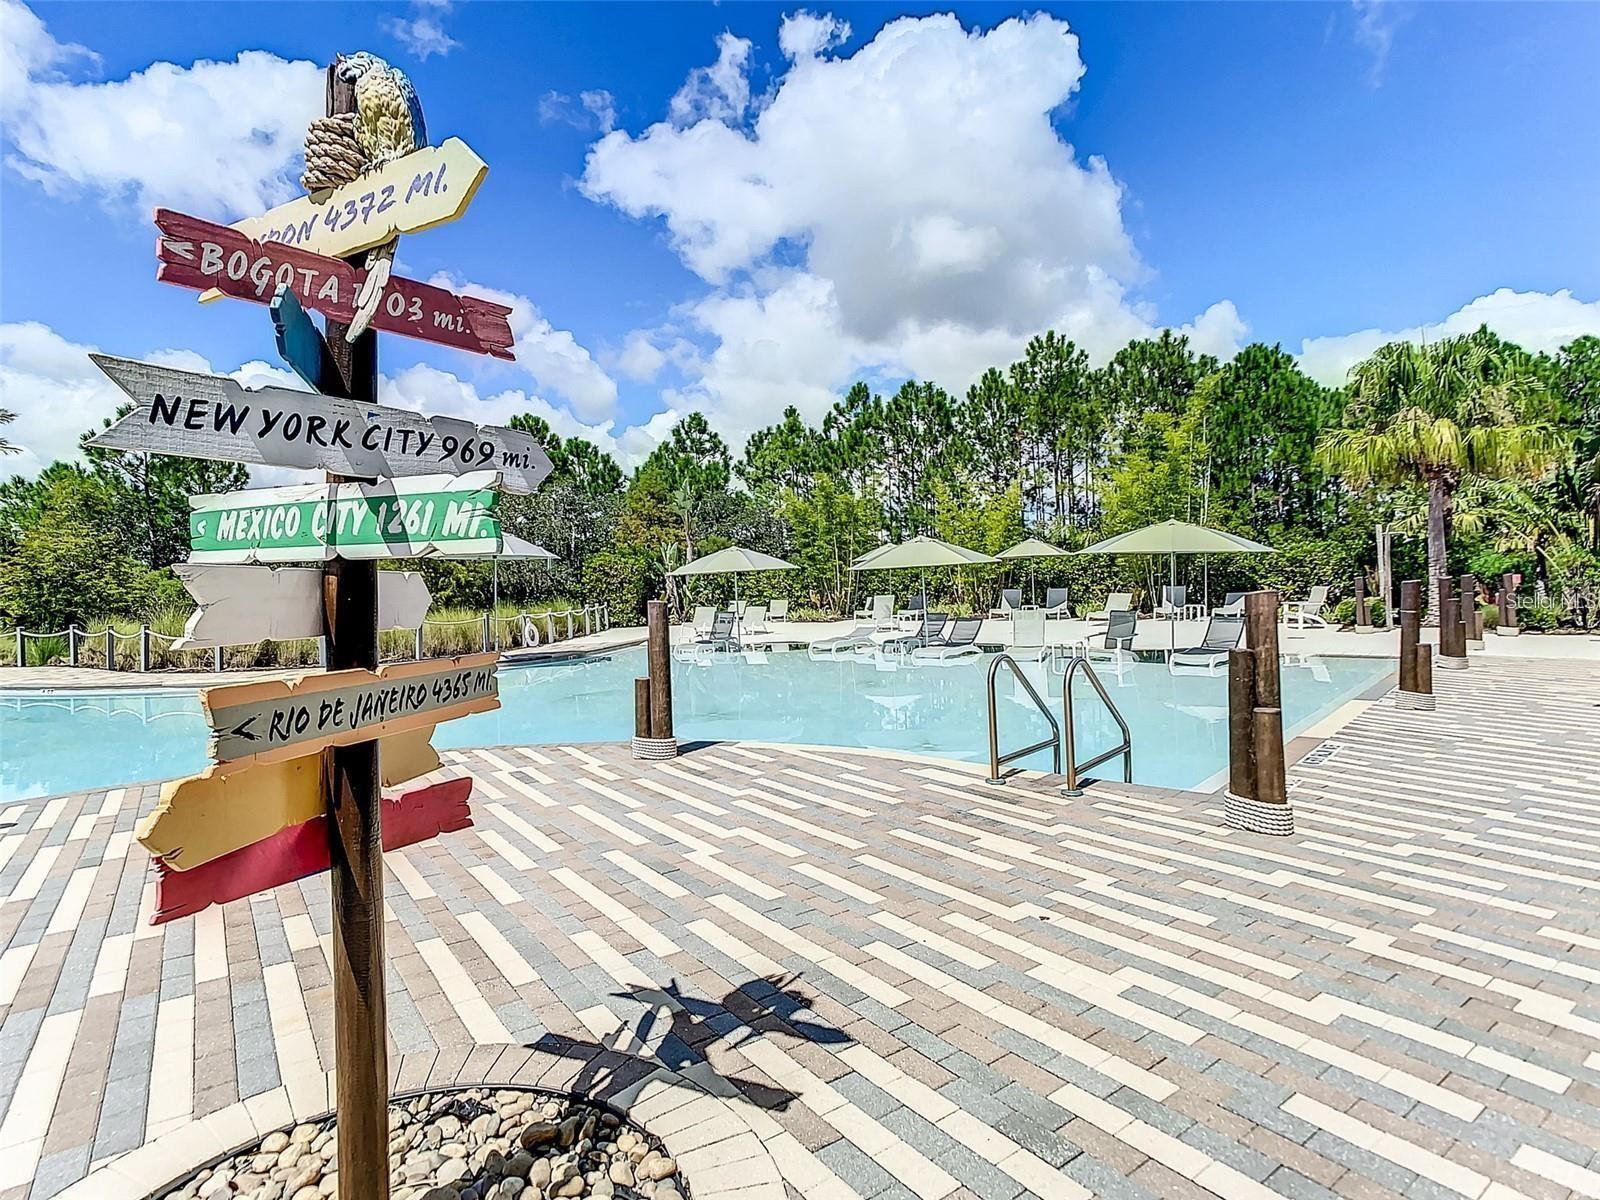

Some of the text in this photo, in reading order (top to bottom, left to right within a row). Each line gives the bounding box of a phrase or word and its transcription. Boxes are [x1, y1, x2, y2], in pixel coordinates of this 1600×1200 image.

[324, 185, 397, 233] 4372
[405, 162, 448, 204] MI.
[200, 242, 471, 334] BOGOTA 103 mi.
[149, 393, 536, 470] NEW YORK CITY 969 mi.
[216, 499, 488, 541] MEXICO CITY 1261 MI.
[268, 670, 493, 742] RIO DE JANEIRO 4365 MI.
